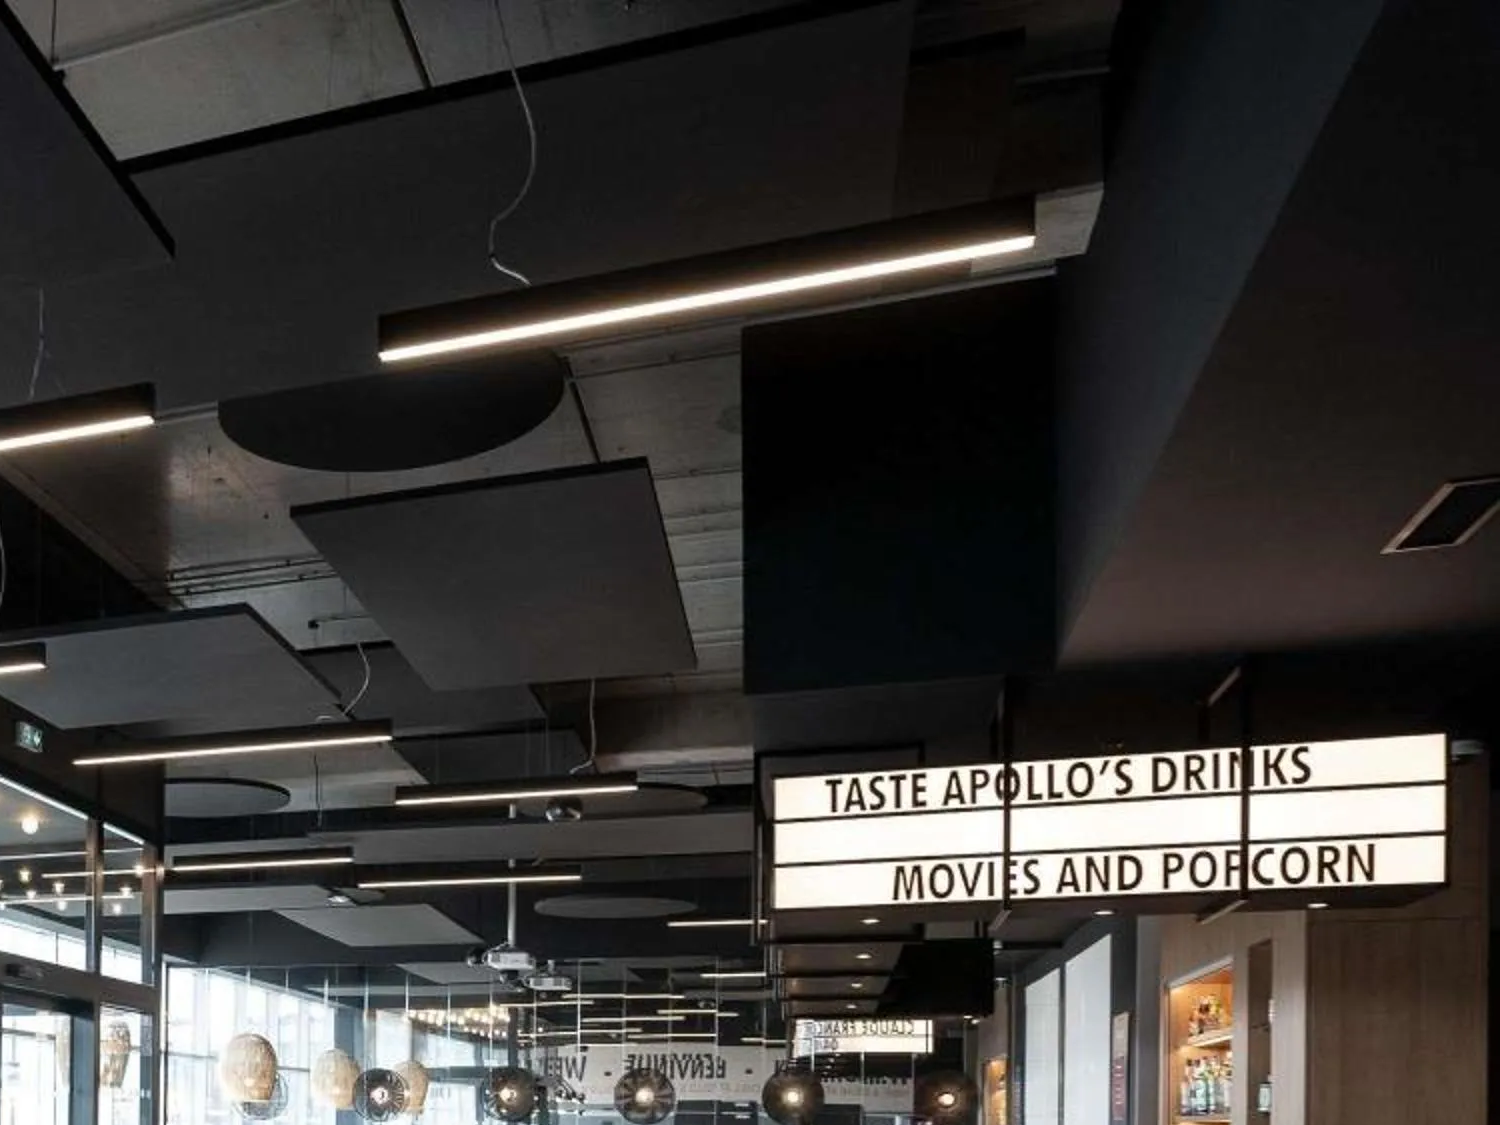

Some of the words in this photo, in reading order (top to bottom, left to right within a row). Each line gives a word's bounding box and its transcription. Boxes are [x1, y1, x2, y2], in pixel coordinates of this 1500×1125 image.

[825, 772, 928, 813] TASTE
[941, 758, 1134, 806] APOLLO'S
[1151, 745, 1312, 793] DRINKS
[893, 858, 1041, 901] MOVIES
[1056, 854, 1143, 894] AND
[1162, 843, 1376, 890] POPCORN
